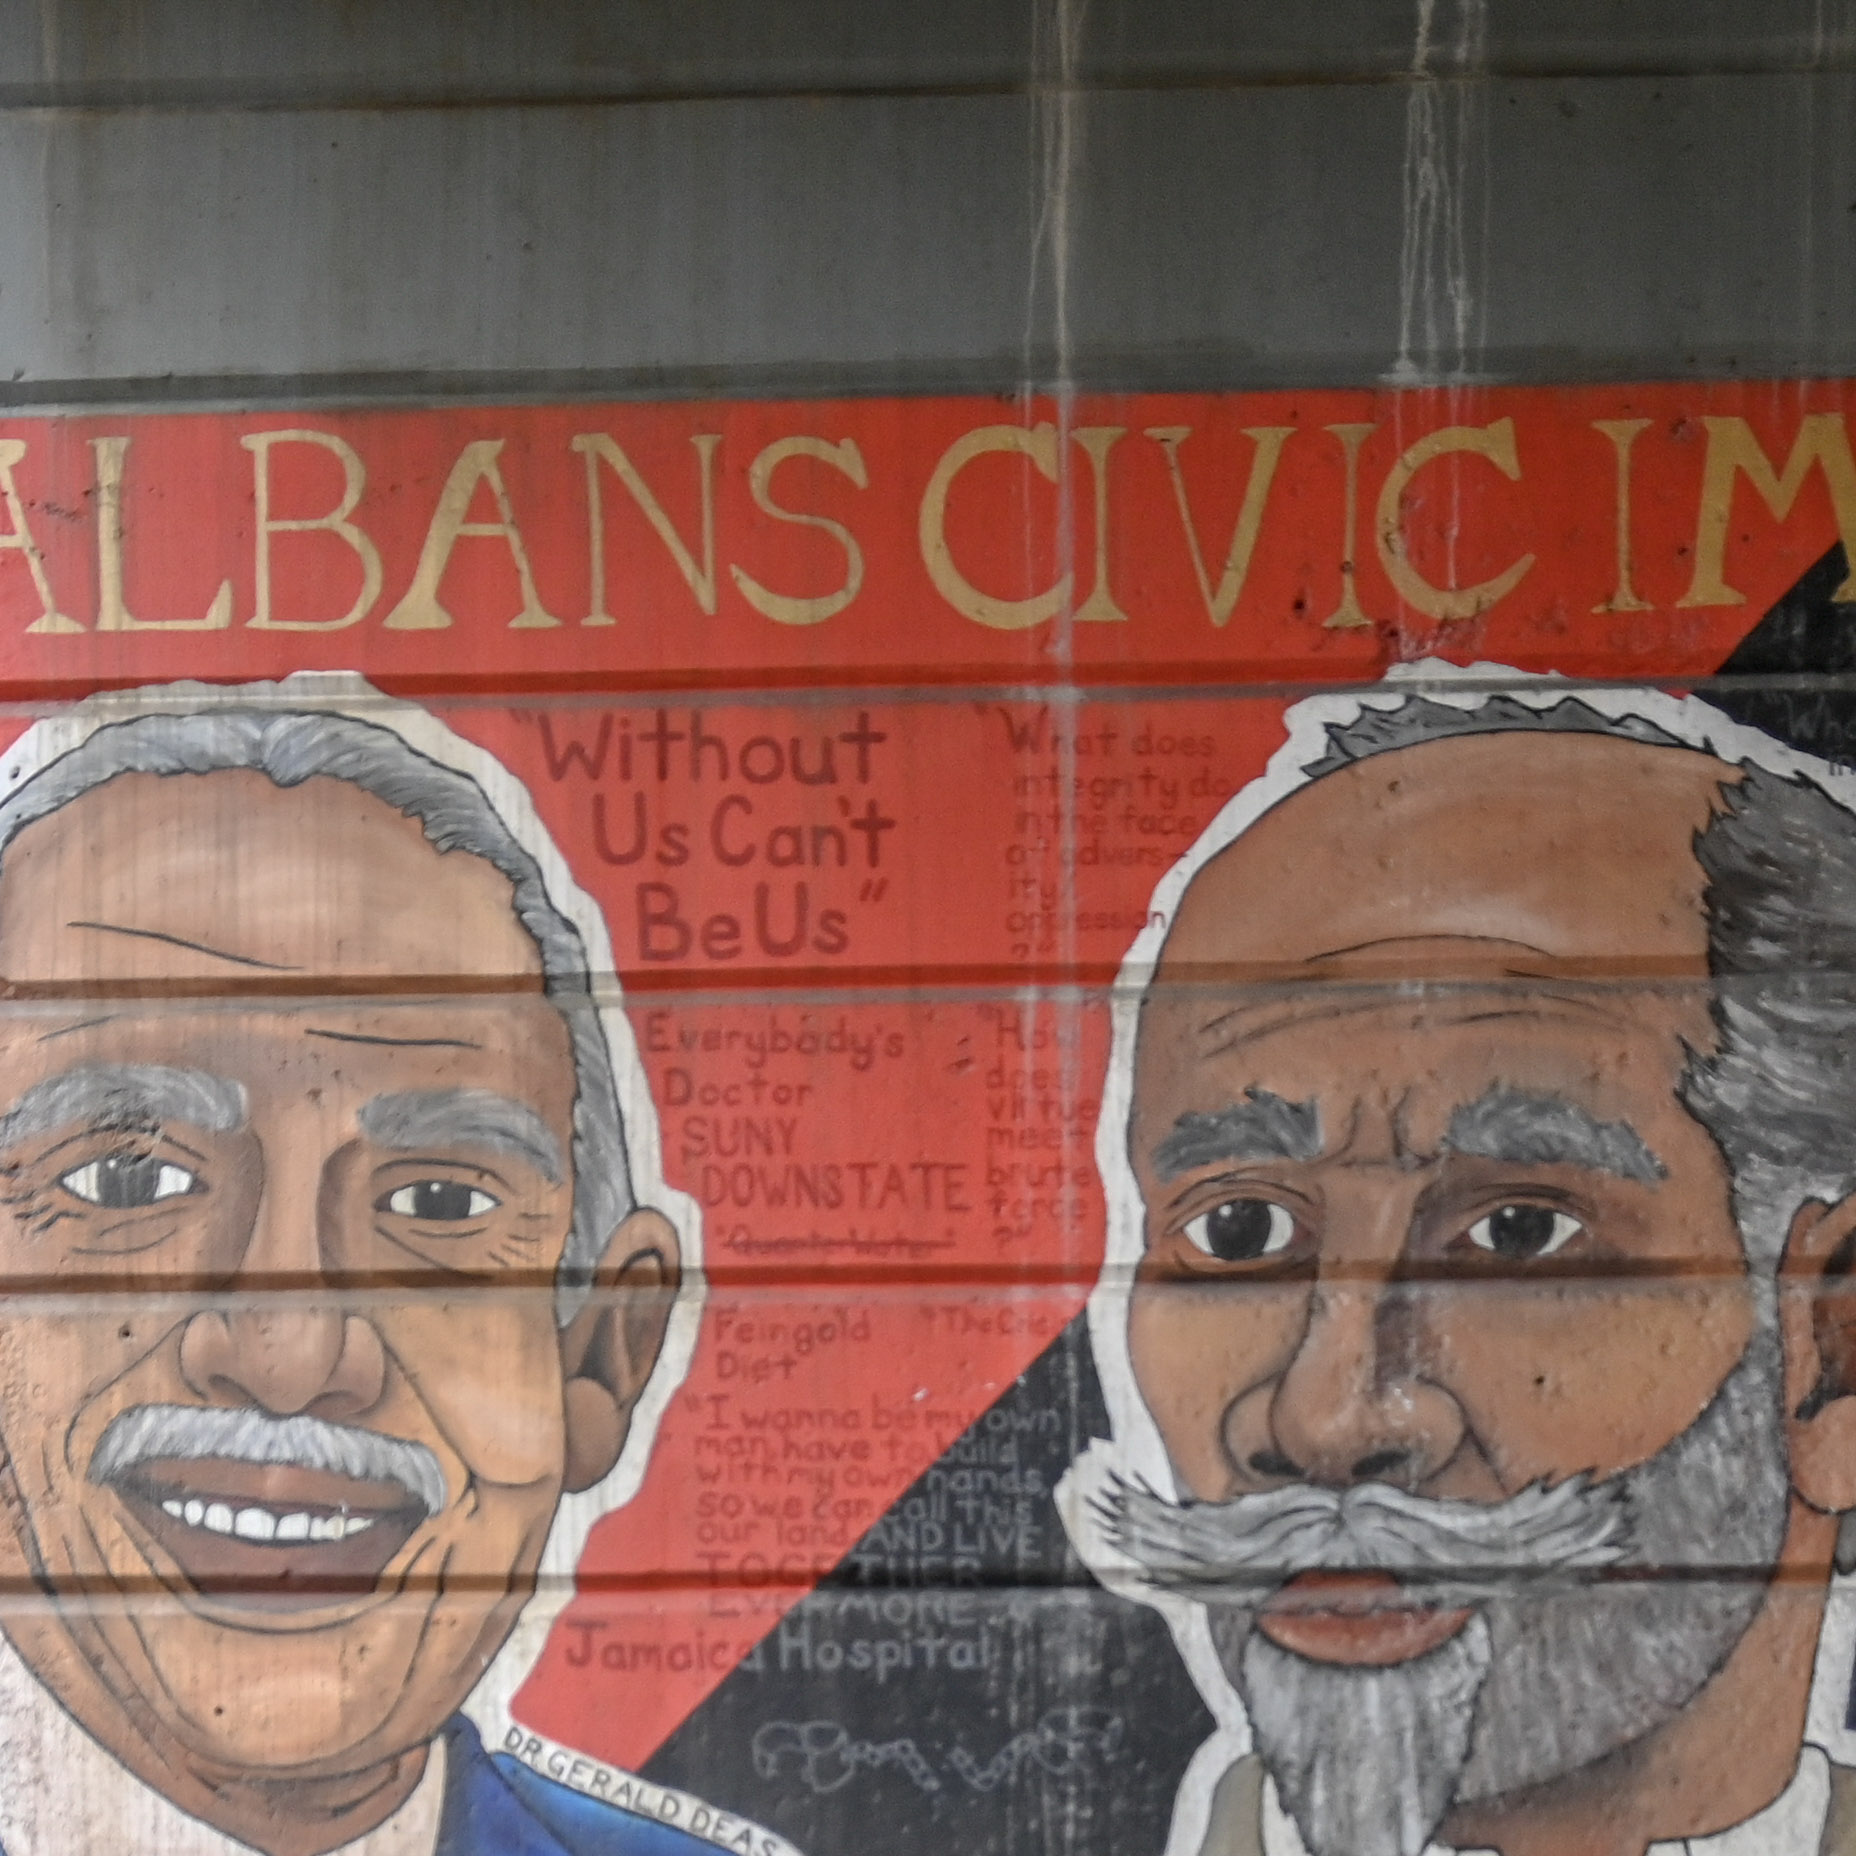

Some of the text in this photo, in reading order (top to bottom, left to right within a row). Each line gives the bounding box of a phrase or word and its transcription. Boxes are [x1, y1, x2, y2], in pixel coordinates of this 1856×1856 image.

[918, 418, 1536, 630] CIVIC
[1131, 721, 1217, 757] does
[592, 791, 690, 867] Us
[635, 880, 744, 962] Be
[680, 1114, 797, 1162] SUNY
[701, 1160, 973, 1213] DOWNSTATE
[782, 1434, 872, 1462] have
[564, 1619, 990, 1683] Jamaica Hospital
[503, 1725, 544, 1764] DR
[547, 1751, 681, 1820] GERALD
